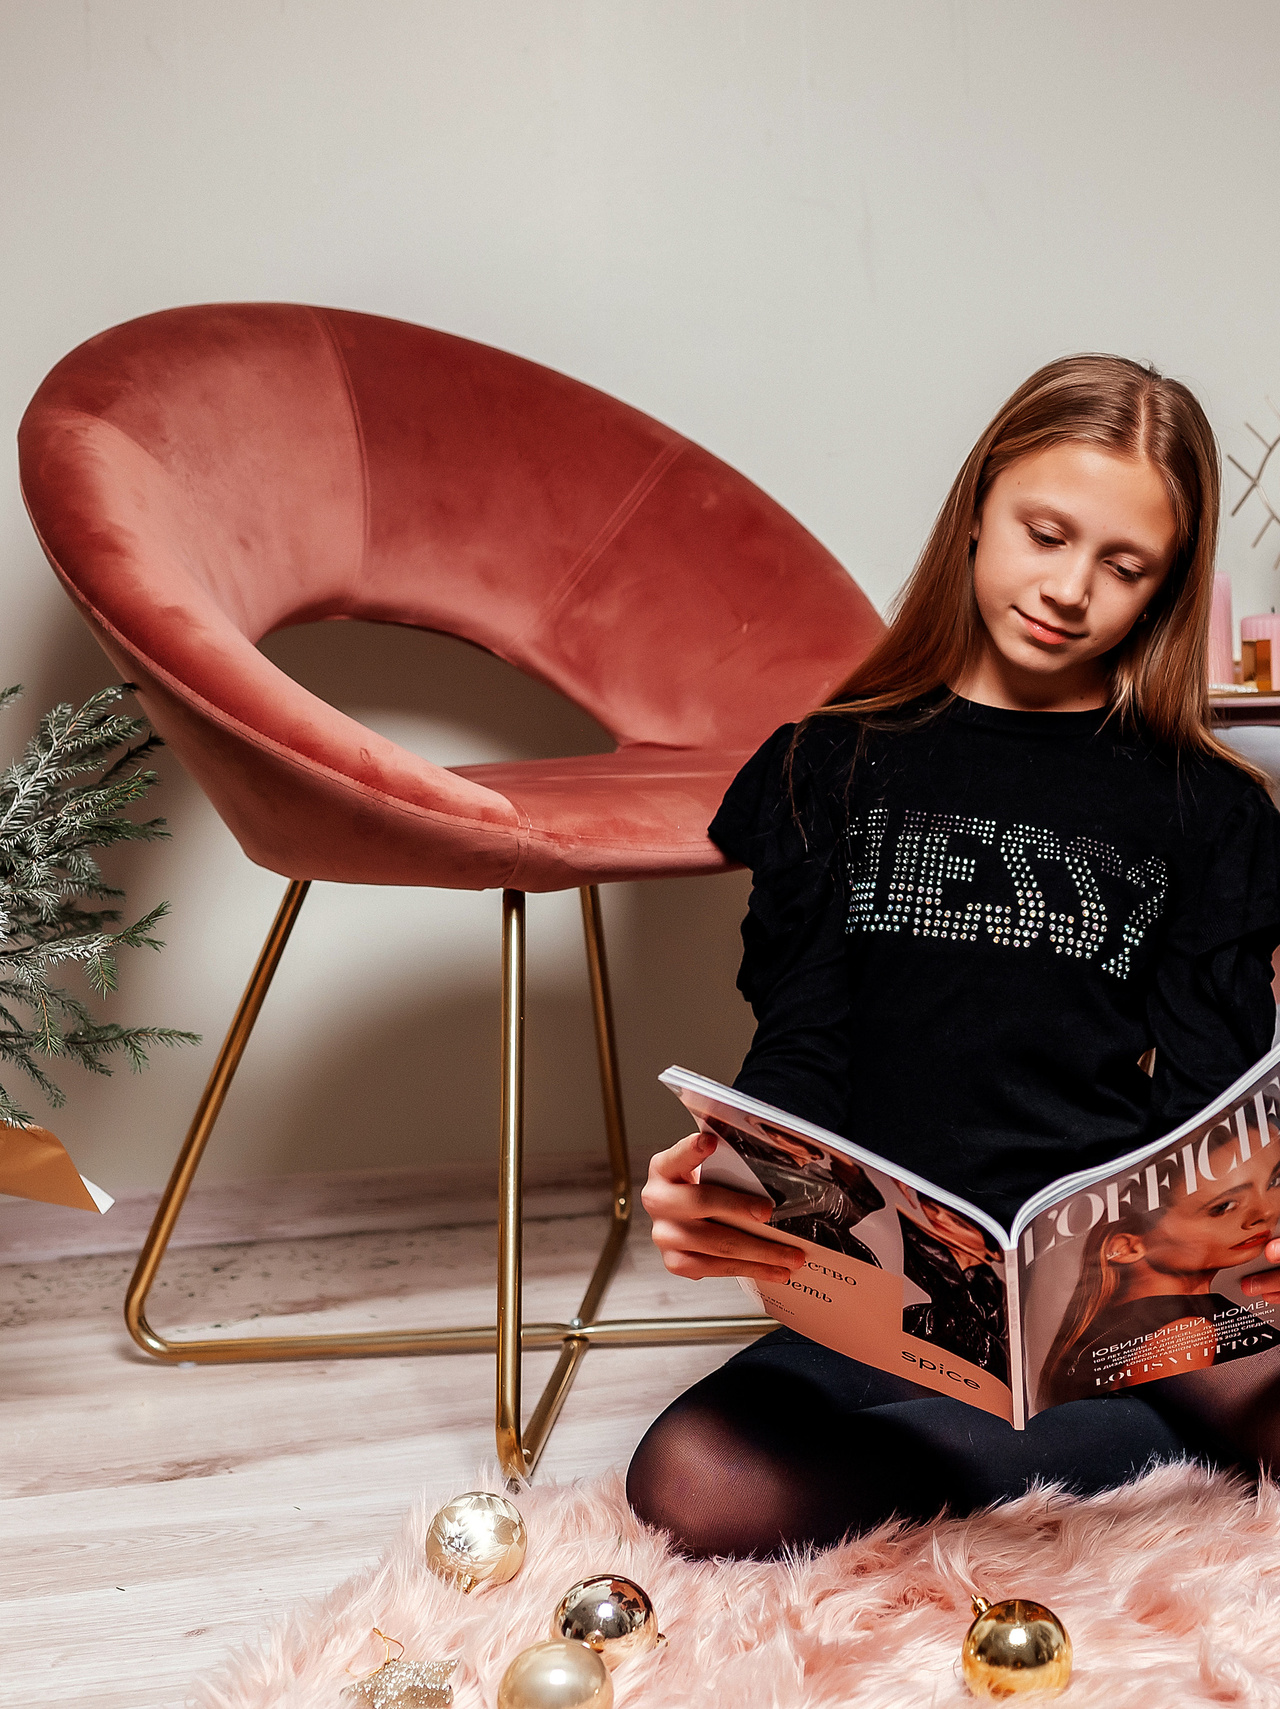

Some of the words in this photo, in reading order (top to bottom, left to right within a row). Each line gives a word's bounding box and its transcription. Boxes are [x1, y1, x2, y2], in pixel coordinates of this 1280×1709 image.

[1092, 1316, 1206, 1358] ЮБИЛЕЙНЫЙ
[1107, 1352, 1122, 1360] ЛЕТ
[1236, 1308, 1275, 1322] ОБЛОЖКИ
[1112, 1346, 1158, 1362] КОСМЕТИКА
[1175, 1329, 1212, 1344] ДЕЛОВОЙ
[1213, 1318, 1255, 1333] ЖЕНЩИНЫ
[1126, 1354, 1158, 1367] LONDON
[1159, 1344, 1192, 1356] FASHION
[1193, 1338, 1214, 1348] WEEK
[1166, 1333, 1210, 1351] КОТОРЫМИ
[1210, 1327, 1240, 1338] НУЖНО
[901, 1348, 981, 1390] spice
[1095, 1361, 1164, 1386] LOUIS
